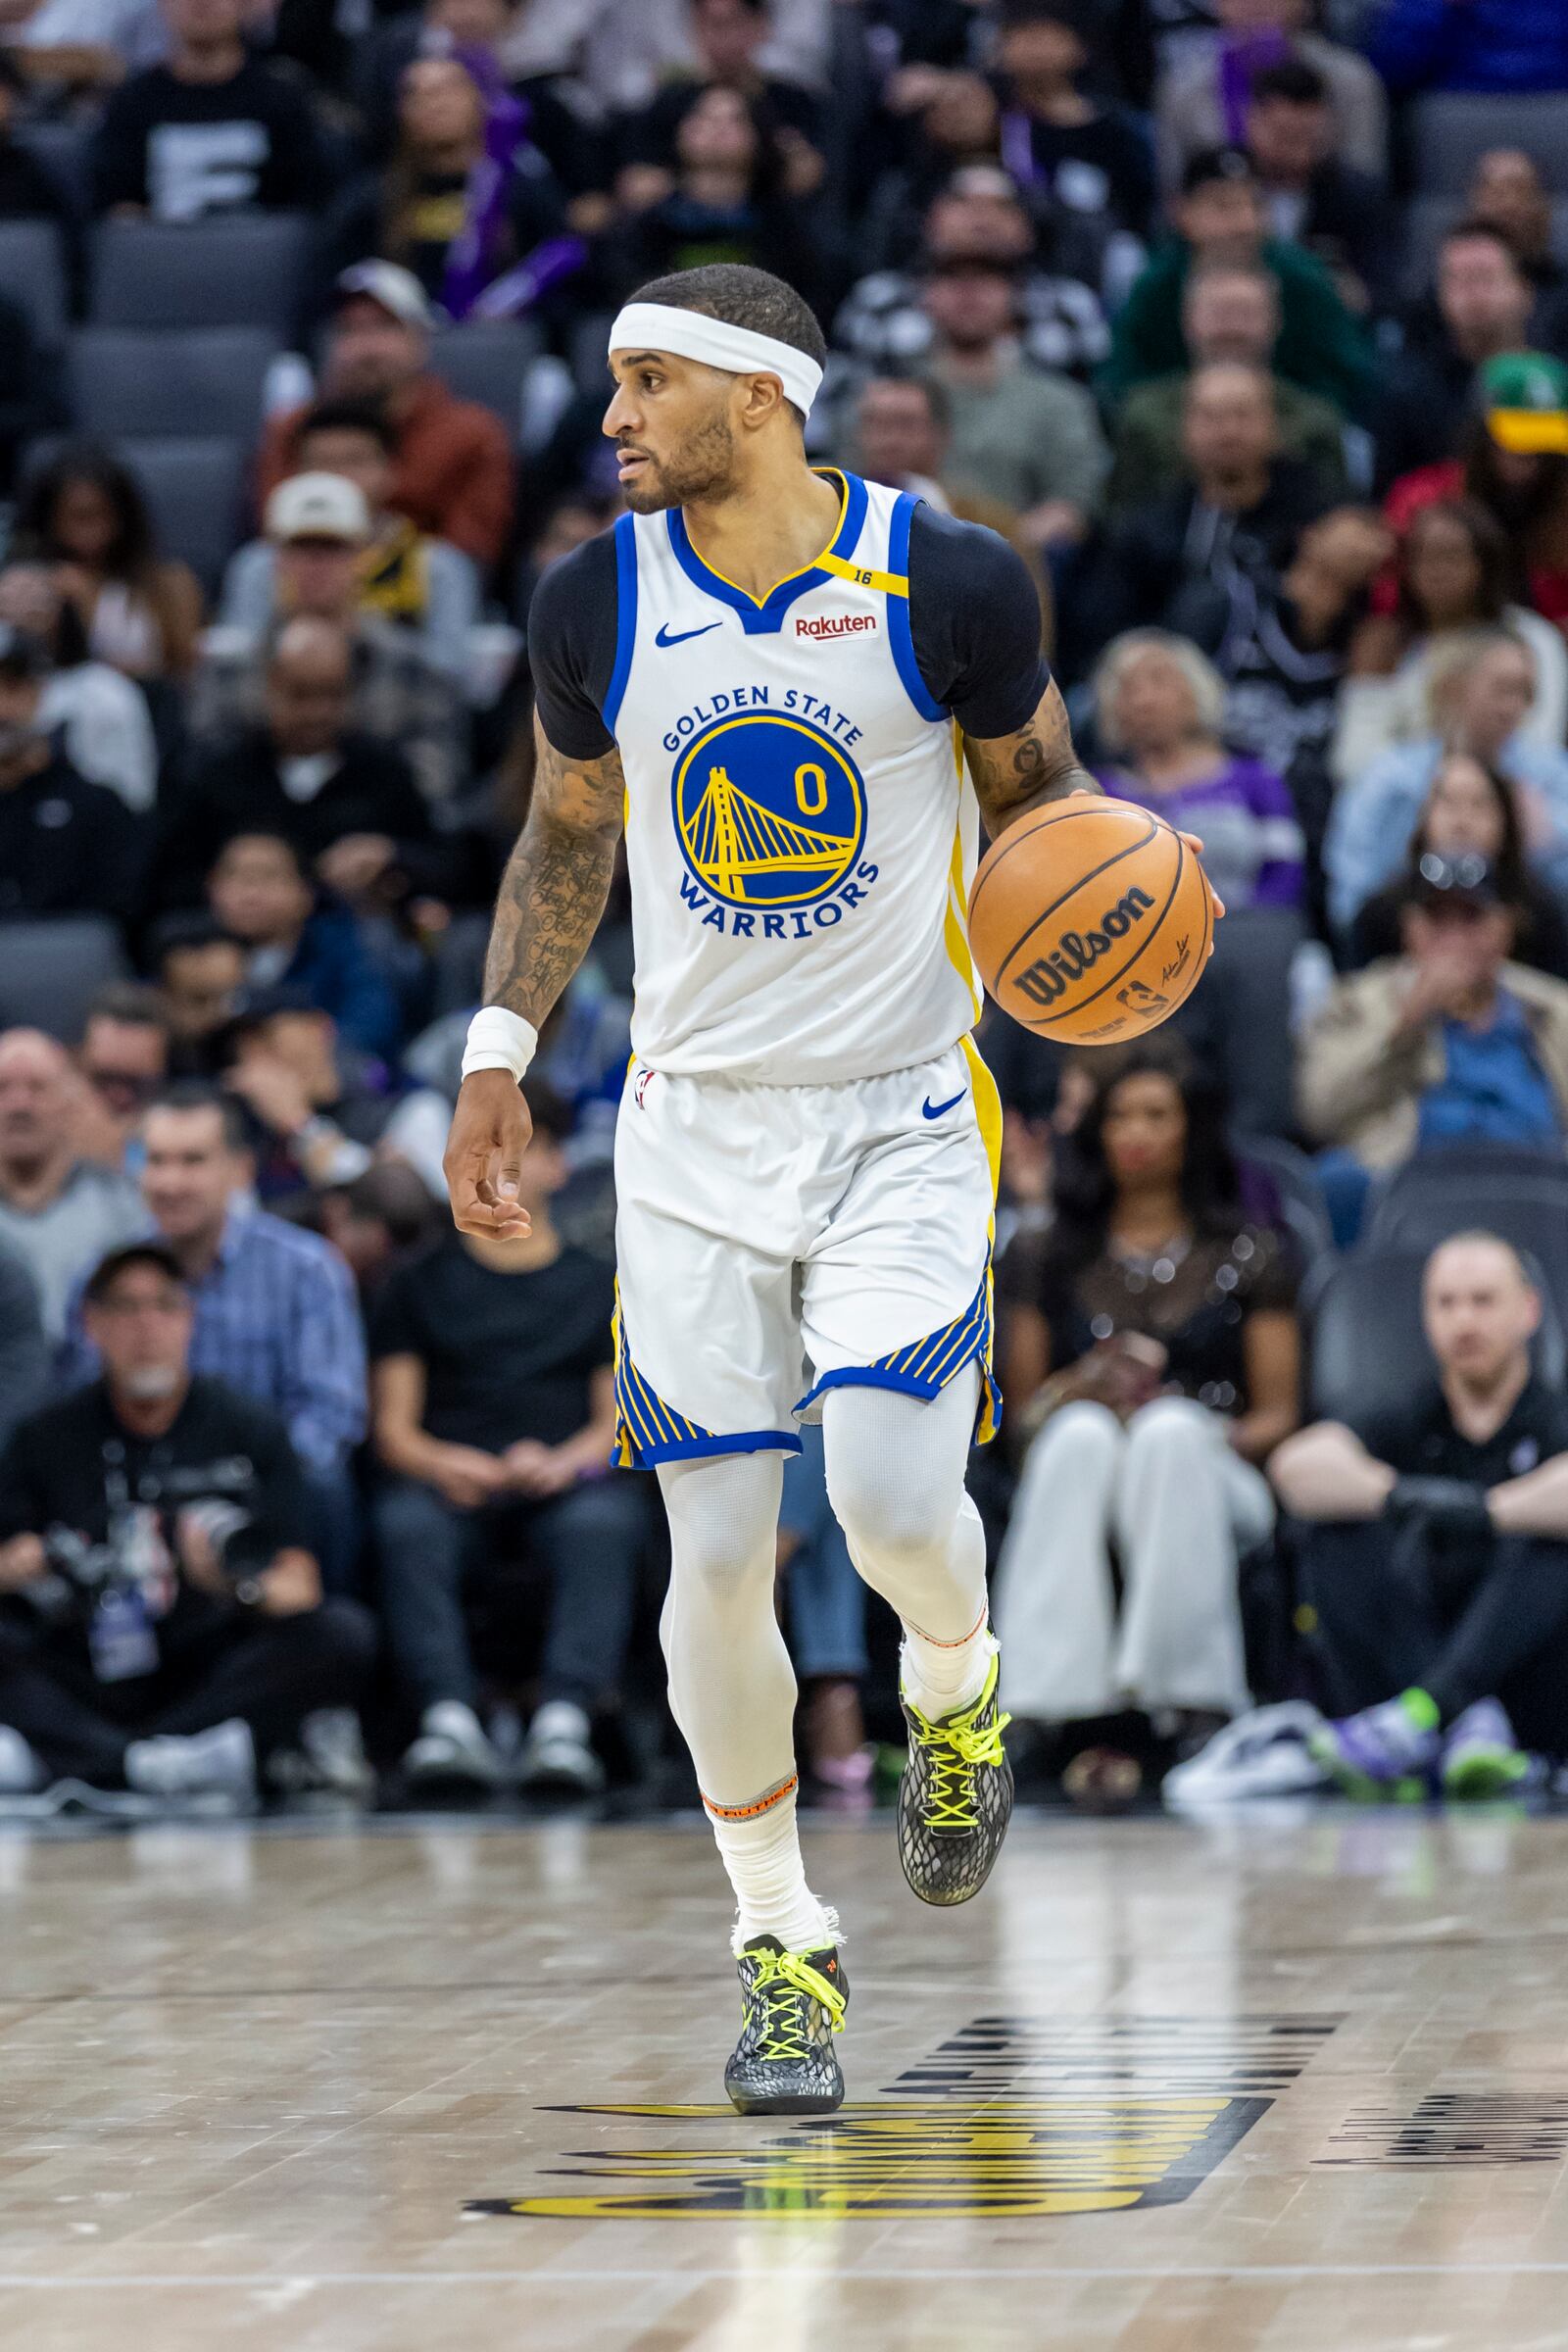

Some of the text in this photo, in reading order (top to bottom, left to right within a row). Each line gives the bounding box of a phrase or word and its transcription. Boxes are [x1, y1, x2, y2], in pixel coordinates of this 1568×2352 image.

[854, 569, 873, 585] 16
[795, 614, 877, 637] Rakuten
[662, 686, 864, 753] GOLDEN STATE
[794, 762, 828, 816] 0
[678, 860, 879, 940] WARRIORS
[1011, 885, 1156, 1006] Wilson
